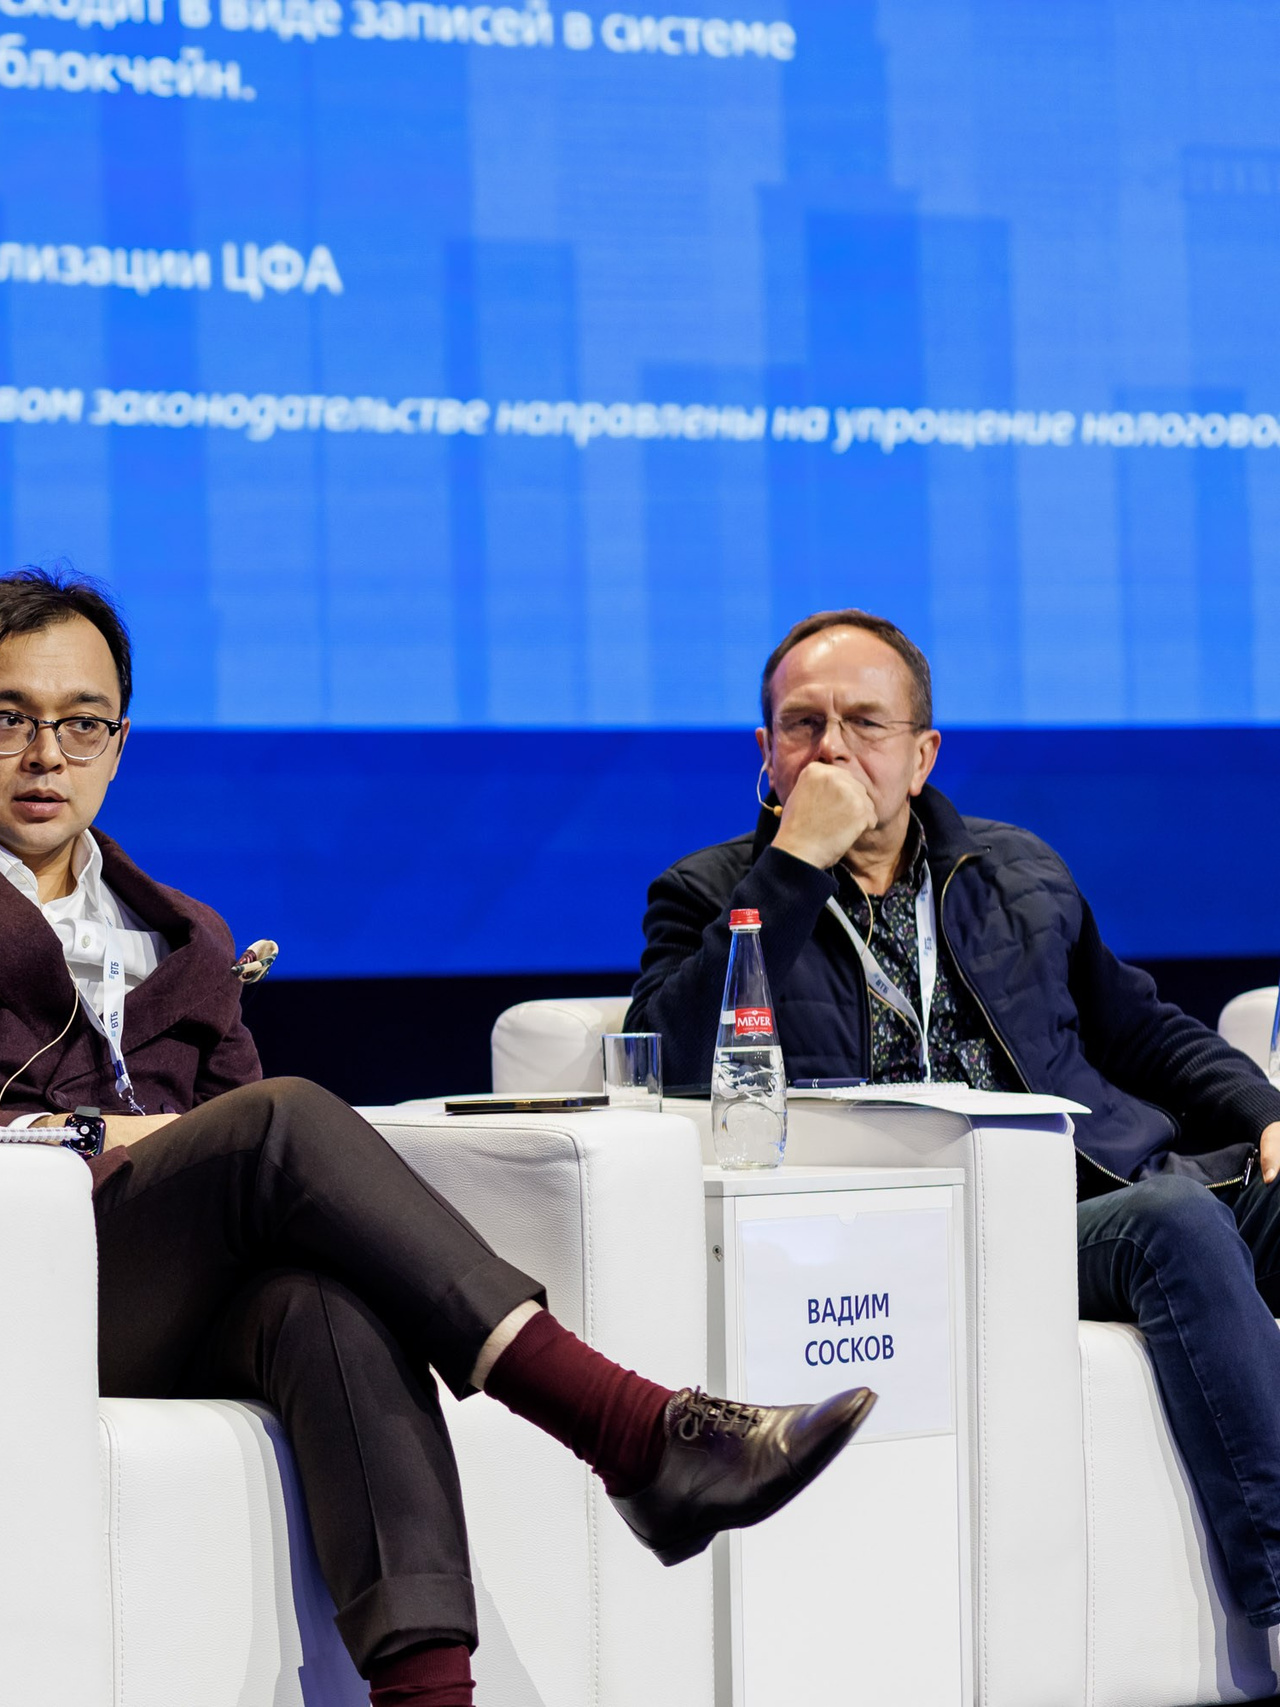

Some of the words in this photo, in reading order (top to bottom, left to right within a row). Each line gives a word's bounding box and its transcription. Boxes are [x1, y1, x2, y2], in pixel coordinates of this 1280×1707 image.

[179, 0, 211, 28] в
[220, 0, 342, 42] виде
[354, 0, 554, 46] записей
[564, 11, 594, 50] в
[601, 13, 796, 60] системе
[223, 244, 343, 299] ЦФА
[91, 388, 490, 440] законодательстве
[496, 401, 767, 448] направлены
[772, 406, 830, 442] на
[832, 407, 1077, 453] упрощение
[111, 961, 119, 975] ВТБ
[875, 978, 888, 994] ВТБ
[111, 1011, 119, 1029] ВТБ
[737, 1016, 771, 1027] MEVER
[807, 1293, 890, 1327] ВАДИМ
[804, 1334, 895, 1367] СОСКОВ
